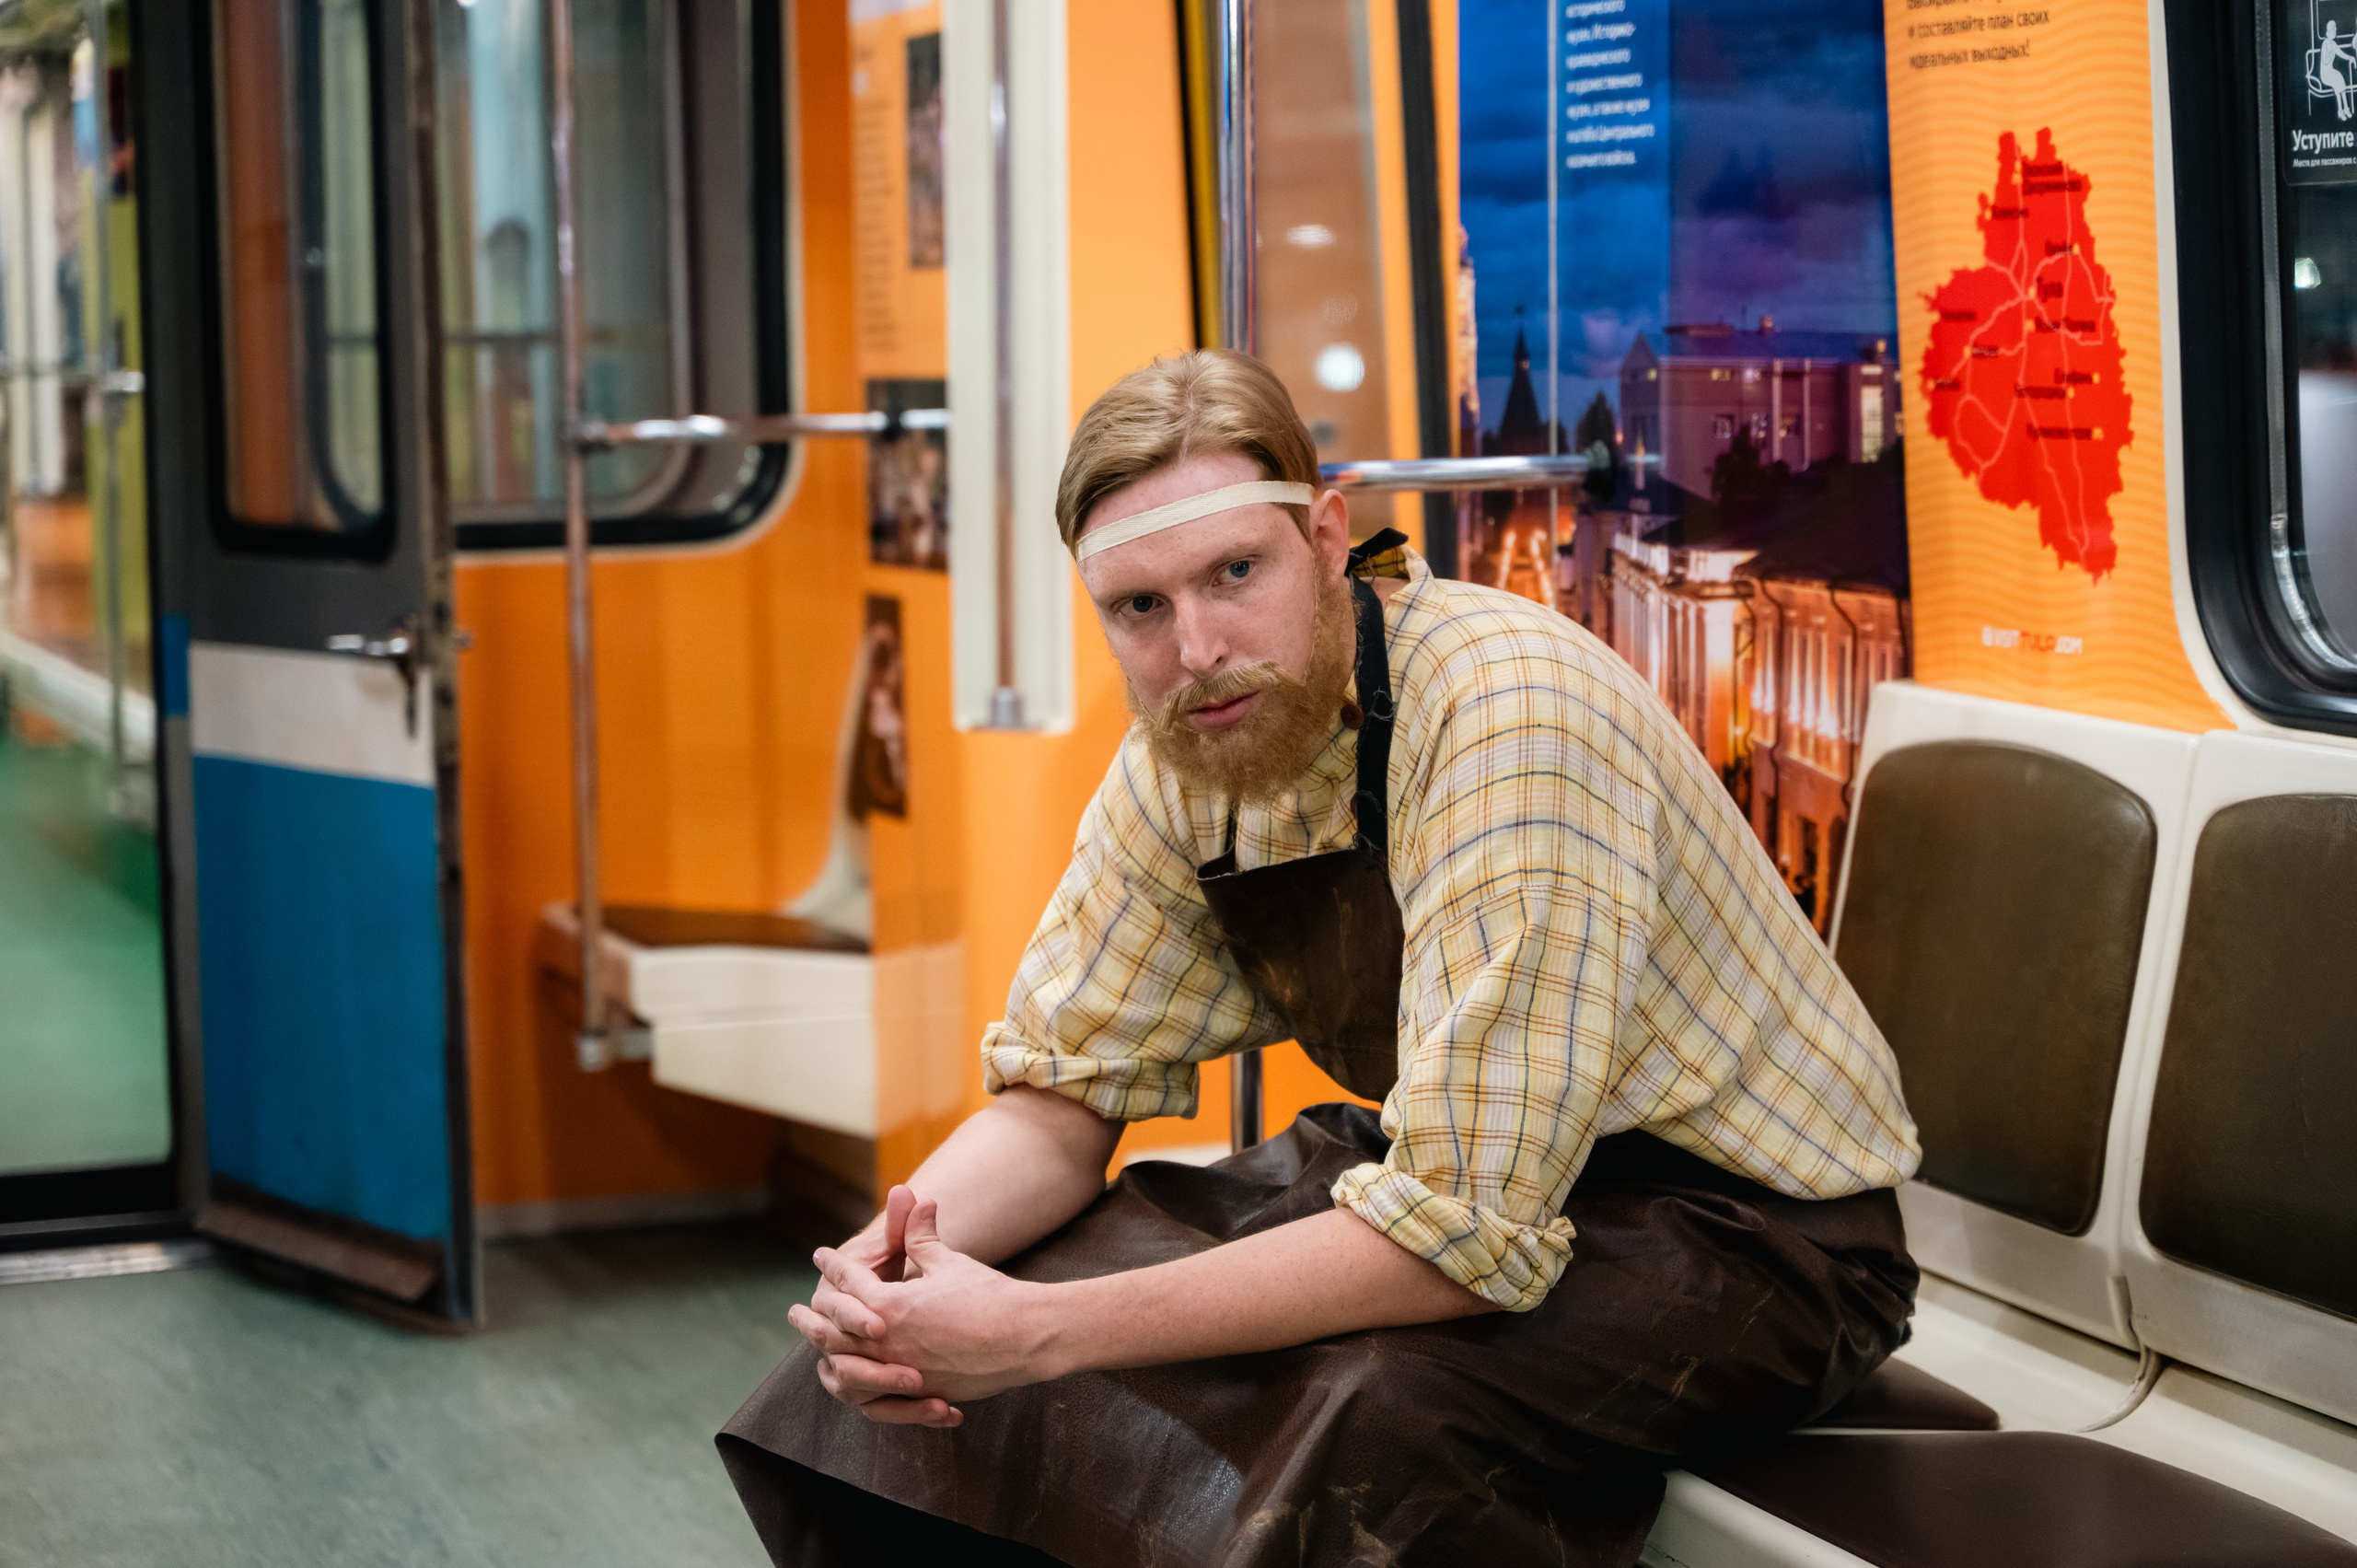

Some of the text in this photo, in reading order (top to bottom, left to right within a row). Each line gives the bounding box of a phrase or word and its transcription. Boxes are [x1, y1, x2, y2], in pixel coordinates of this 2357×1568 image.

[1908, 10, 2049, 39] и составляйте план своих
[1910, 38, 2030, 70] идеальных выходных!
[2292, 128, 2355, 155] Уступите
[2321, 157, 2352, 167] пассажиров
[2037, 277, 2062, 303] Тула
